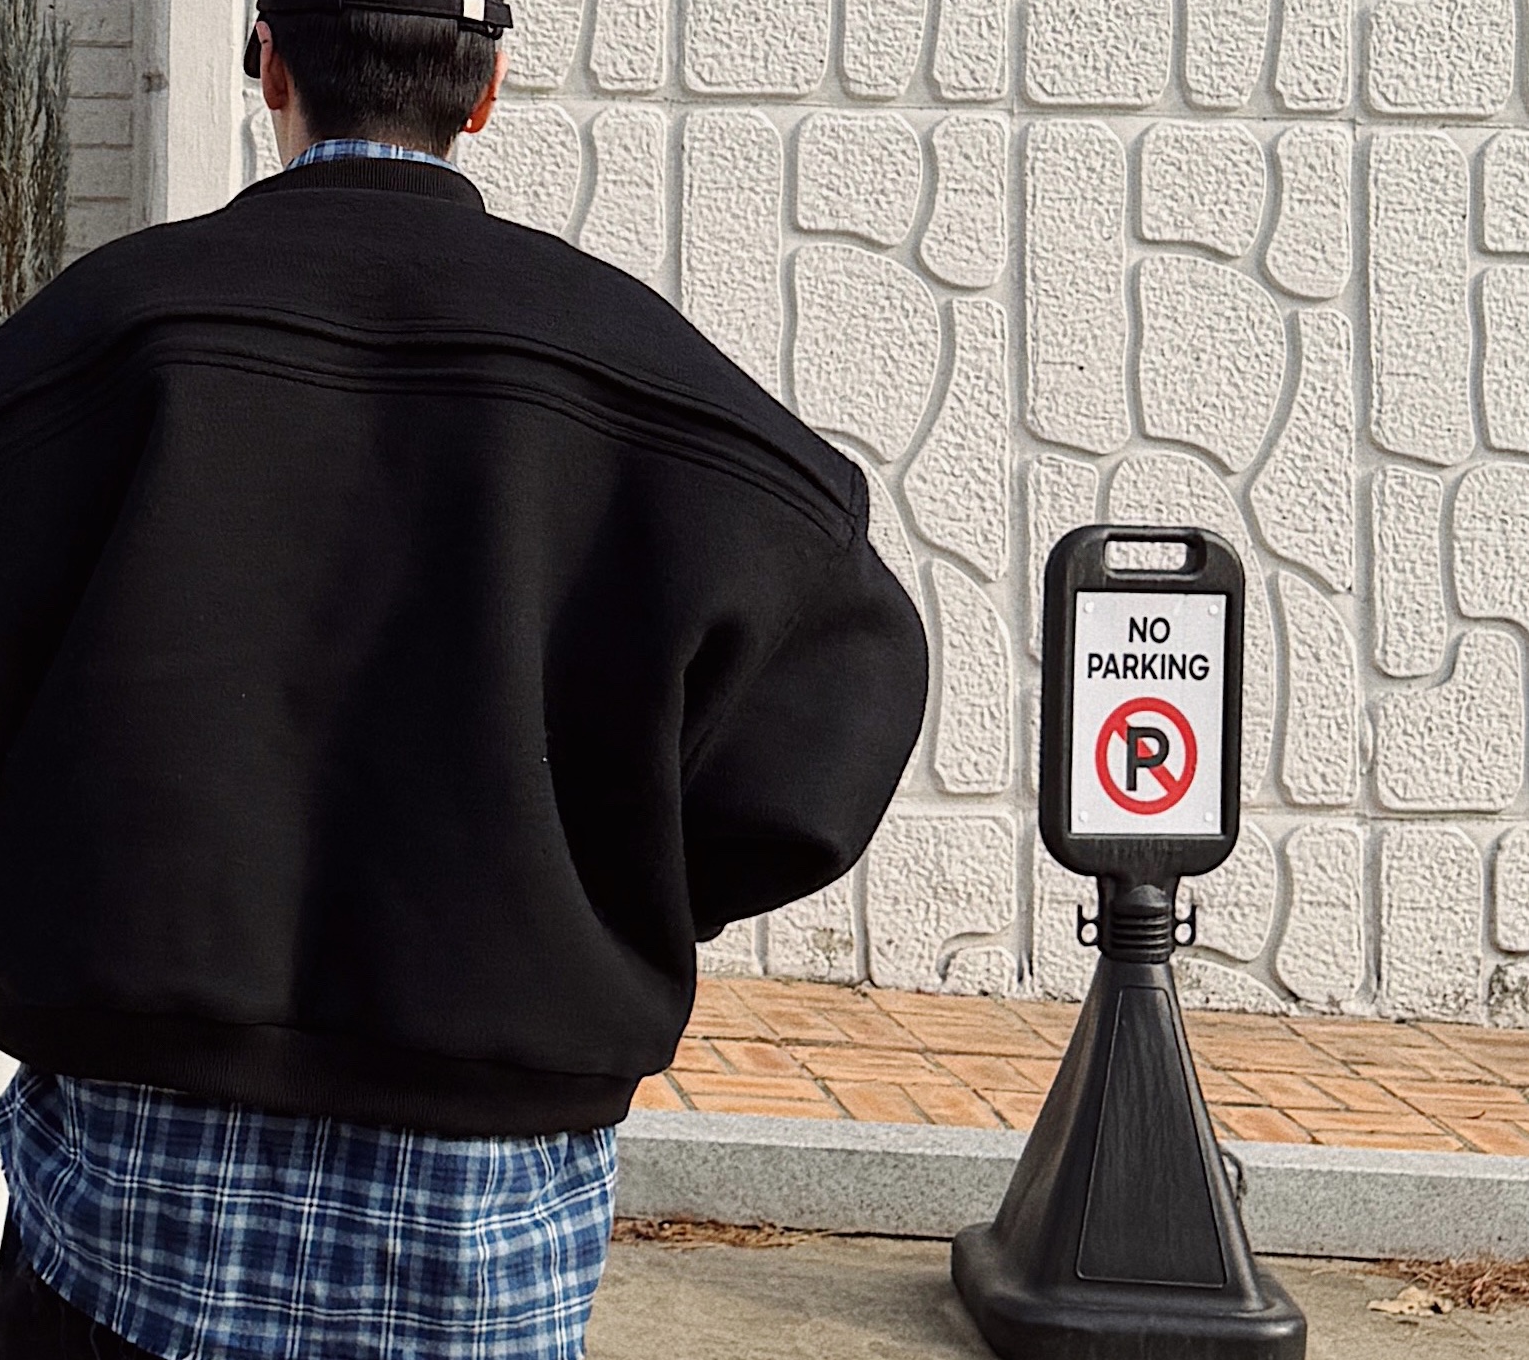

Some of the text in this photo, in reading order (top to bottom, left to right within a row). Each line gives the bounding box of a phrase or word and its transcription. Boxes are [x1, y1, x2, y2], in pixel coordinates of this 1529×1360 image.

[1128, 616, 1171, 644] NO
[1087, 653, 1210, 681] PARKING
[1126, 726, 1170, 792] P
